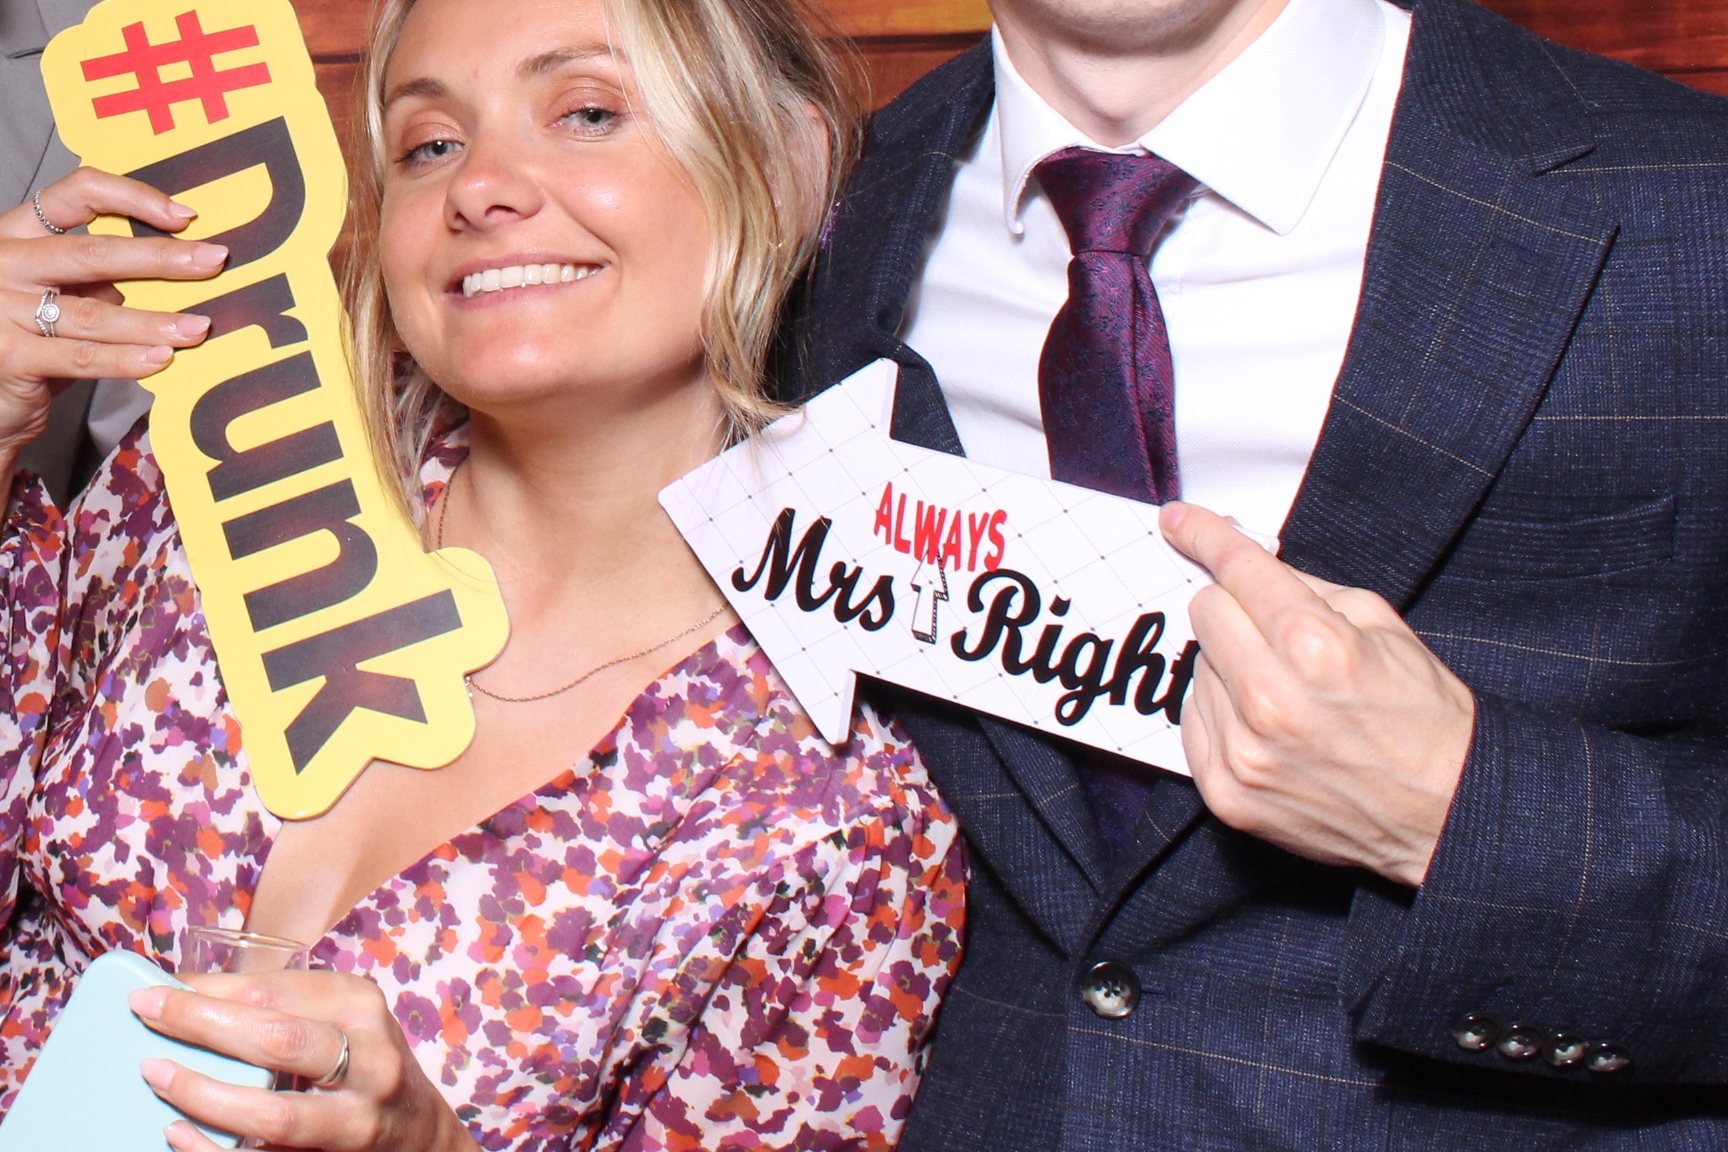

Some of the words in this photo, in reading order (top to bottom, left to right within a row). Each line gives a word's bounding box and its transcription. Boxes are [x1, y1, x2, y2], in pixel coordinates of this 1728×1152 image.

[79, 9, 463, 776] #Drunk
[731, 507, 895, 632] Mrs
[874, 481, 1008, 572] ALWAYS
